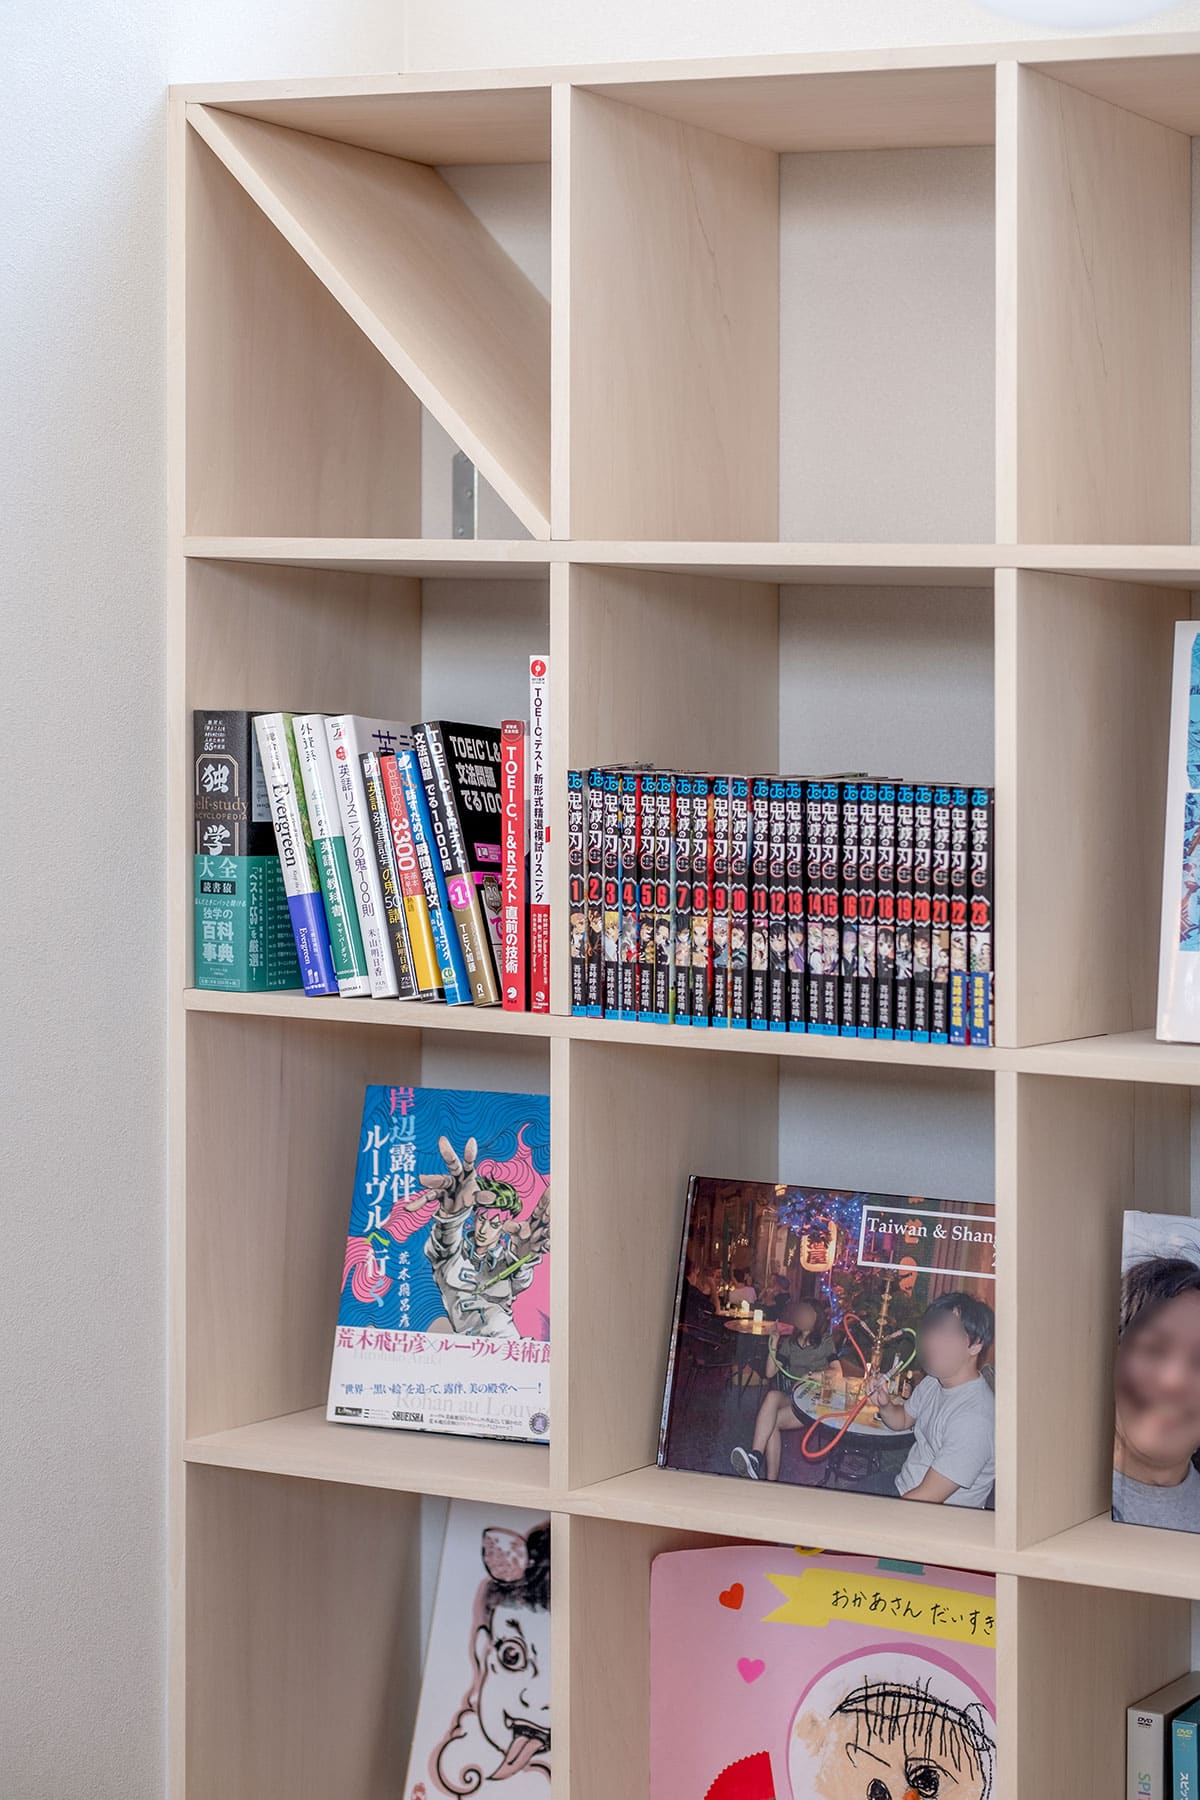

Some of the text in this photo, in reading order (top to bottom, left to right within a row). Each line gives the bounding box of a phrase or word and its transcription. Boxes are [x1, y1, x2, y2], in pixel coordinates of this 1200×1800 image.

[455, 762, 496, 788] 文法問題
[196, 796, 248, 815] elf-study
[272, 783, 296, 868] Evergreen
[391, 818, 415, 871] 3300
[200, 857, 238, 878] 大全
[572, 880, 578, 900] 1
[590, 877, 599, 900] 2
[606, 883, 615, 905] 3
[623, 884, 633, 905] 4
[641, 884, 652, 905] 5
[657, 885, 667, 907] 6
[678, 887, 687, 908] 7
[694, 887, 705, 910] 8
[715, 888, 726, 910] 9
[733, 890, 747, 911] 10
[753, 890, 766, 912] 11
[770, 892, 785, 914] 12
[788, 892, 803, 914] 13
[808, 893, 821, 916] 14
[822, 894, 838, 916] 15
[843, 895, 857, 917] 16
[860, 896, 875, 918] 17
[878, 896, 894, 918] 18
[898, 897, 912, 920] 19
[914, 898, 930, 920] 20
[933, 899, 948, 922] 21
[971, 902, 988, 924] 23
[389, 1086, 417, 1203] 岸辺露伴
[363, 1125, 391, 1308] ルーヴルへ行く
[868, 1217, 927, 1237] Taiwan
[933, 1223, 947, 1239] &
[831, 1588, 995, 1635] おかあさん だいすき
